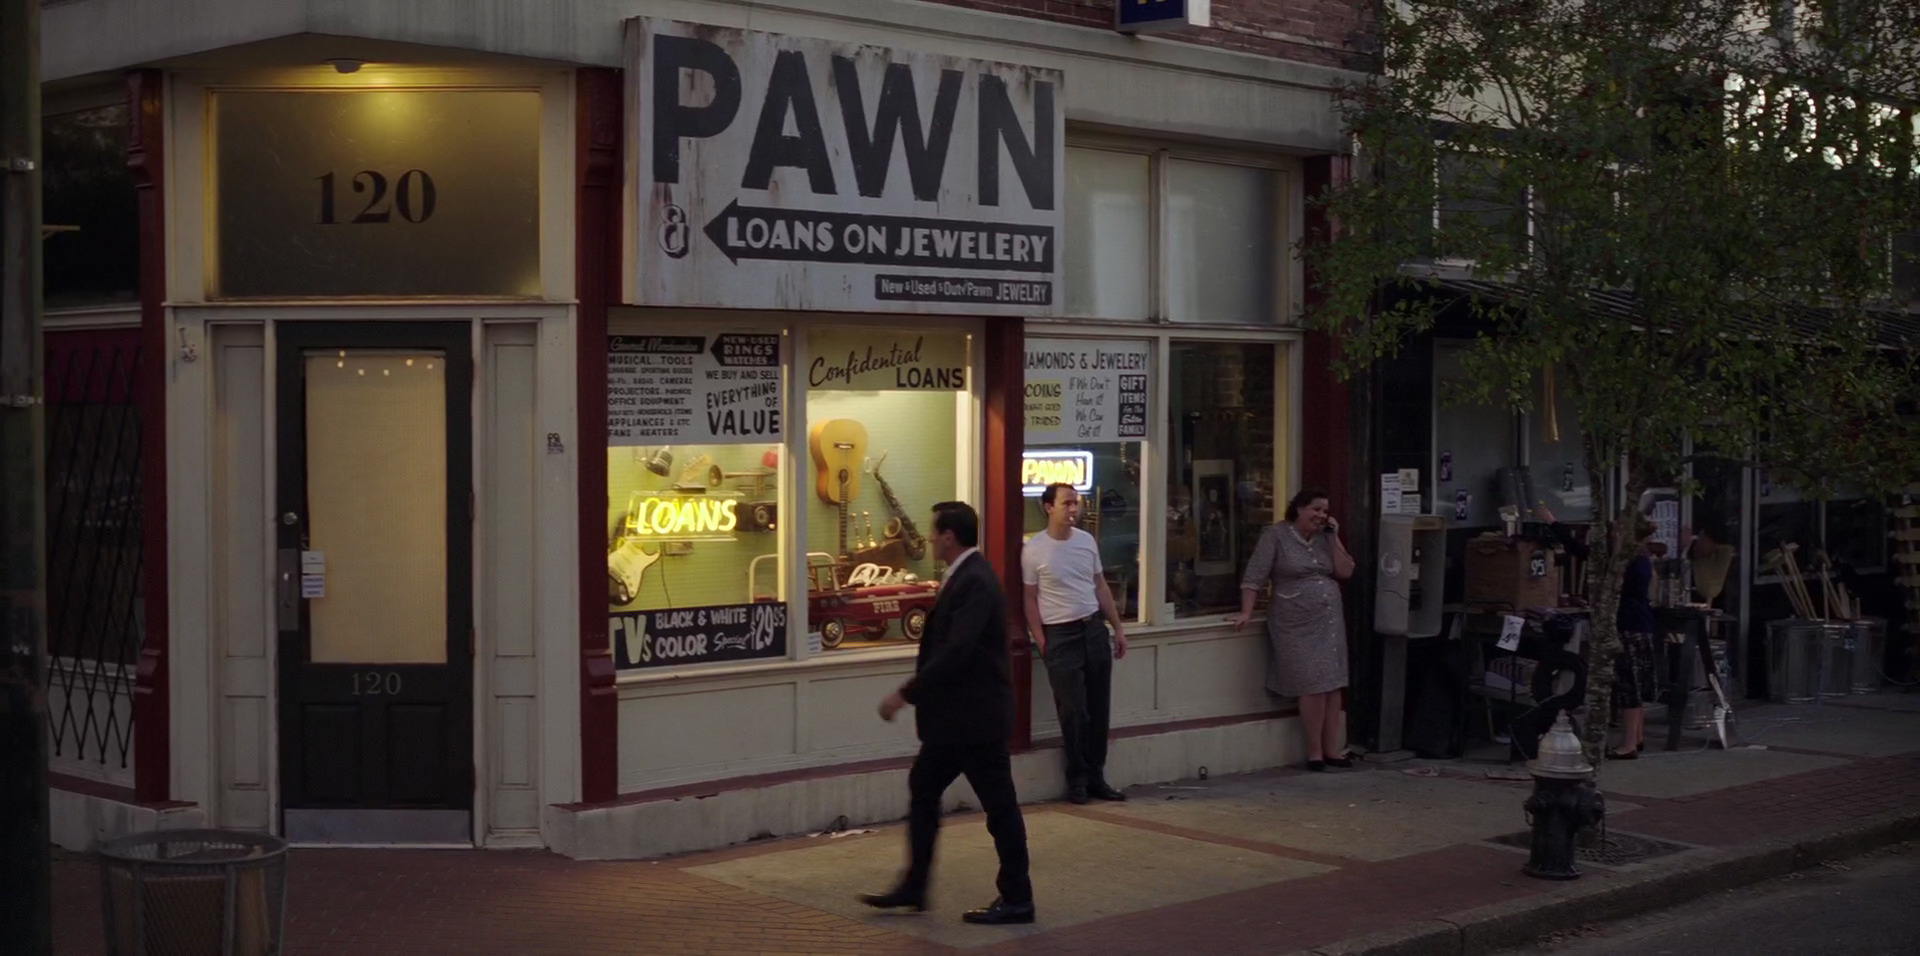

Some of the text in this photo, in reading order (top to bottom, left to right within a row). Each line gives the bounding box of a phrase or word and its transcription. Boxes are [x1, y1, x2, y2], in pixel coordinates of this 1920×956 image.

[653, 33, 1055, 211] PAWN
[312, 168, 437, 225] 120
[657, 204, 1048, 263] & LOANS ON JEWELERY
[881, 278, 904, 294] New
[911, 279, 937, 296] Used
[996, 283, 1048, 303] JEWELRY
[608, 355, 694, 366] MUSICAL TOOLS
[723, 345, 774, 356] RINGS
[1080, 352, 1088, 370] &
[1092, 348, 1148, 370] JEWELERY
[808, 336, 924, 388] Confidential
[660, 377, 693, 386] CAMERAS
[705, 369, 779, 380] WE BUY AND SELL
[896, 367, 965, 389] LOANS
[1120, 376, 1145, 391] GIFT
[608, 396, 685, 406] OFFICE EQUIPMENT
[706, 381, 777, 410] EVERYTHING
[1024, 383, 1062, 398] COINS
[1120, 392, 1146, 404] ITEMS
[764, 396, 779, 408] OF
[608, 417, 665, 427] APPLIANCES
[640, 428, 679, 438] HEATERS
[707, 409, 781, 436] VALUE
[1022, 457, 1085, 486] PAWN
[636, 498, 738, 535] LOANS
[872, 599, 901, 614] FIRE
[655, 611, 695, 630] BLACK
[698, 611, 708, 627] &
[710, 607, 748, 626] WHITE
[655, 633, 708, 660] COLOR
[352, 671, 402, 696] 120
